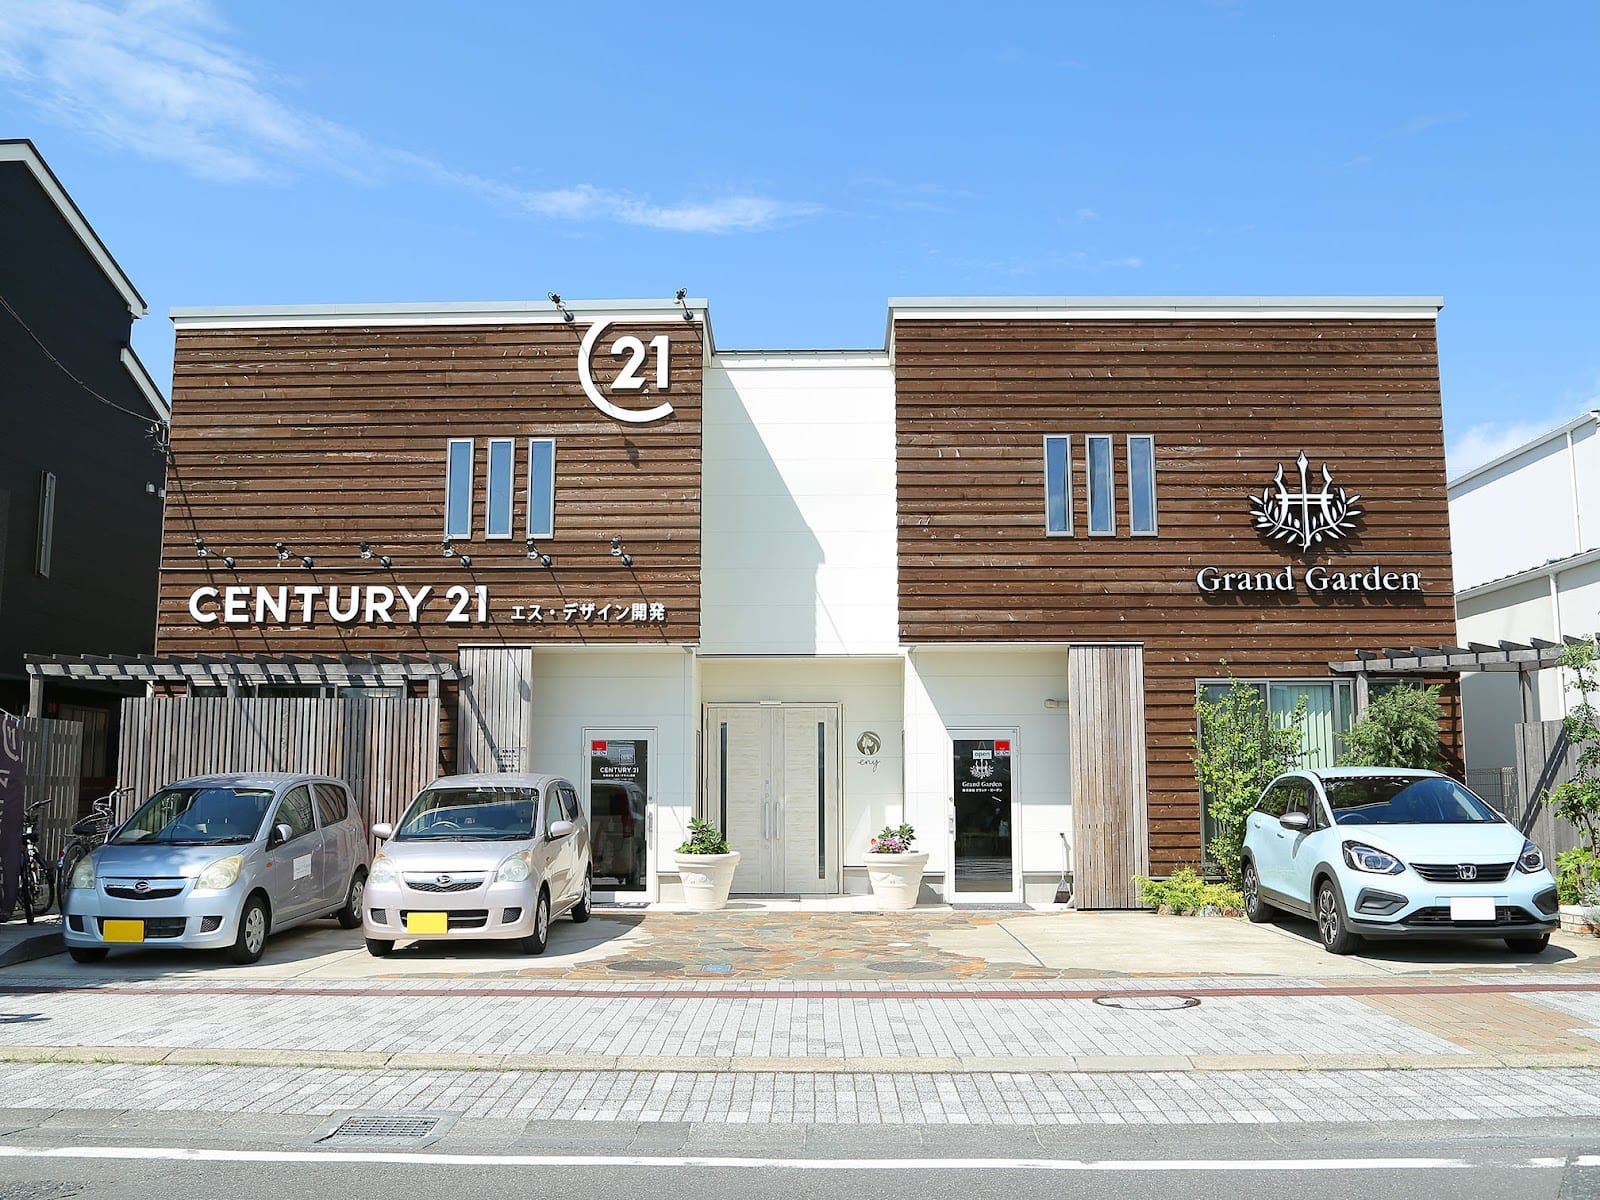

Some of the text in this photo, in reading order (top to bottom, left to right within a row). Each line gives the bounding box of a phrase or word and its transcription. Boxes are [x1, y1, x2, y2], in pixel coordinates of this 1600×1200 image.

[1196, 565, 1421, 592] Grand Garden
[188, 585, 488, 623] CENTURY 21
[510, 602, 666, 622] エス・デザイン開発
